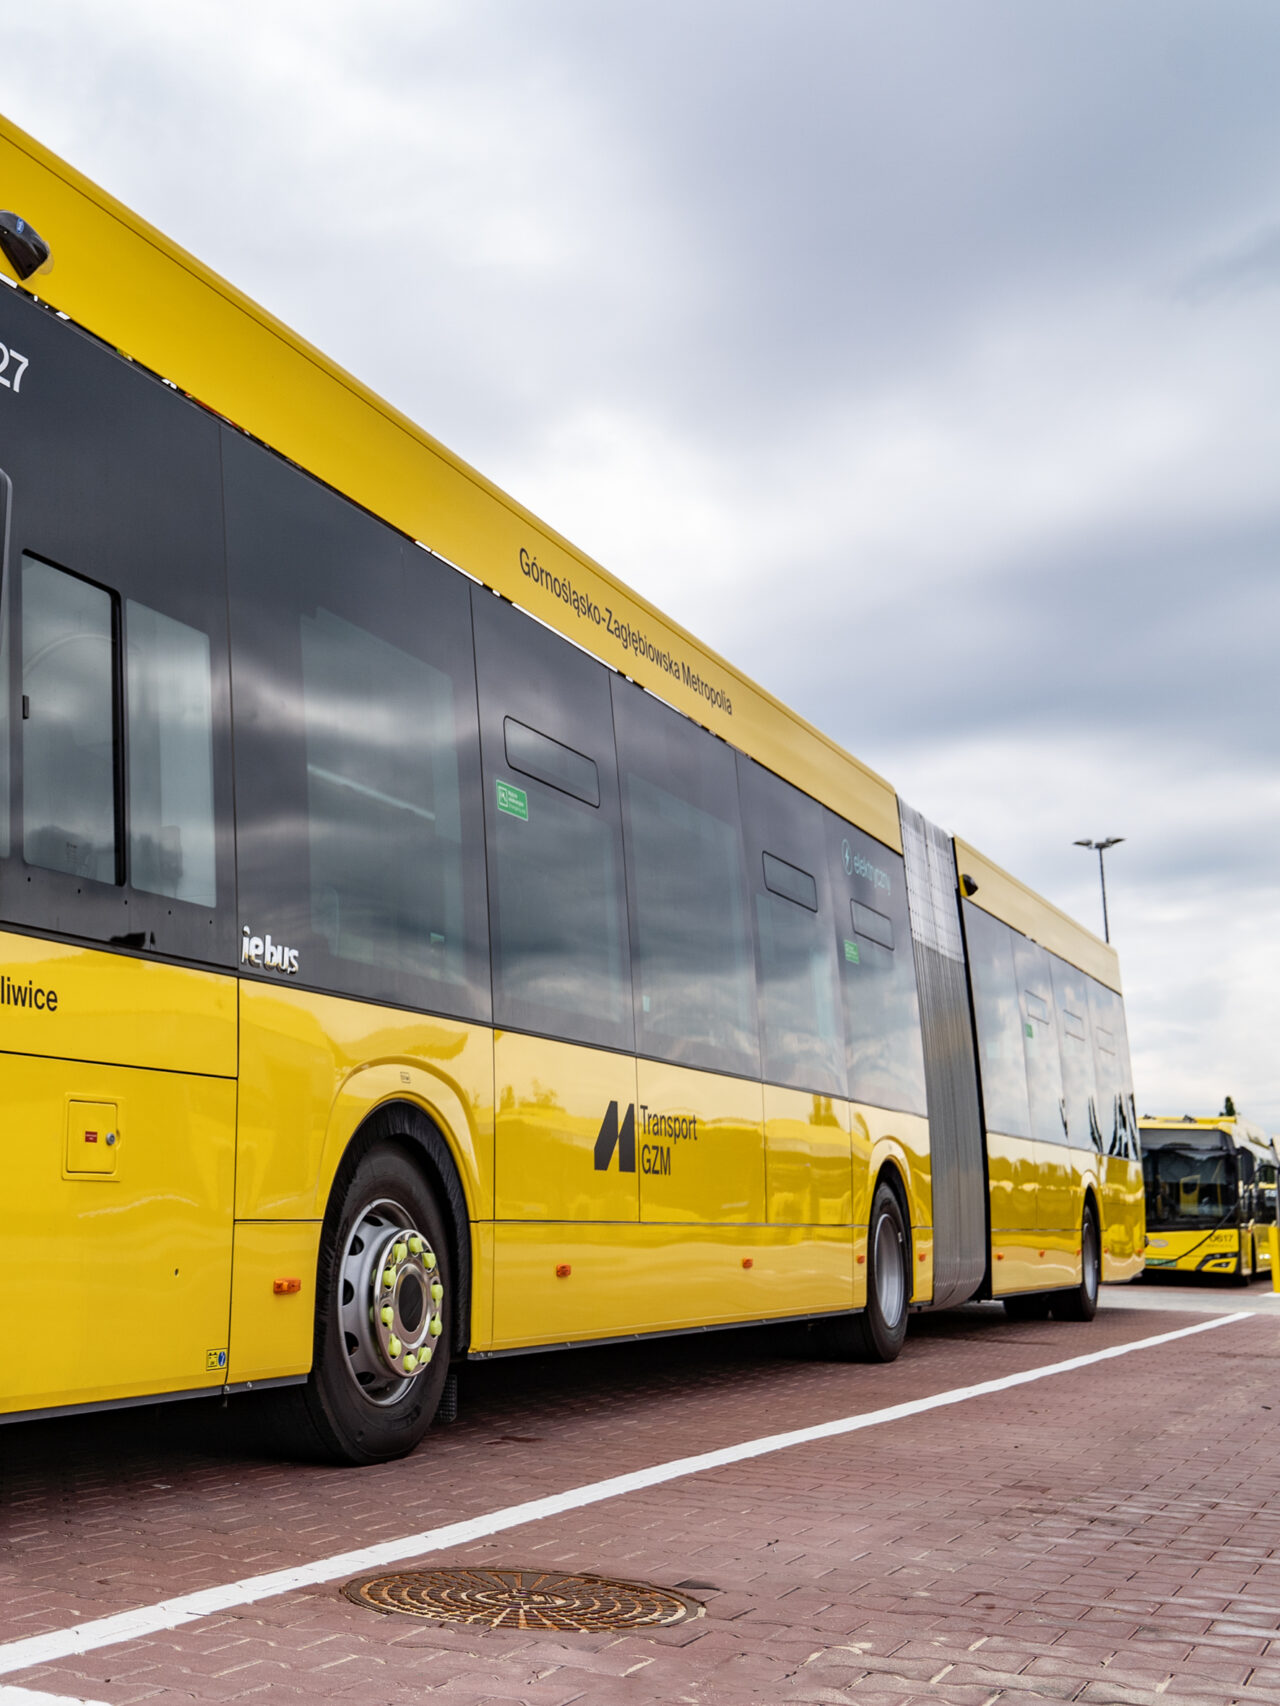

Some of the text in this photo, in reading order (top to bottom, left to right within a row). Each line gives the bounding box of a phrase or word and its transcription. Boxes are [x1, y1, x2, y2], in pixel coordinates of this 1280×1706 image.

[519, 547, 733, 715] Górnośląsko-Zagłębiowska Metropolia
[241, 925, 300, 976] iebus
[640, 1105, 698, 1144] Transport
[641, 1144, 671, 1176] GZM
